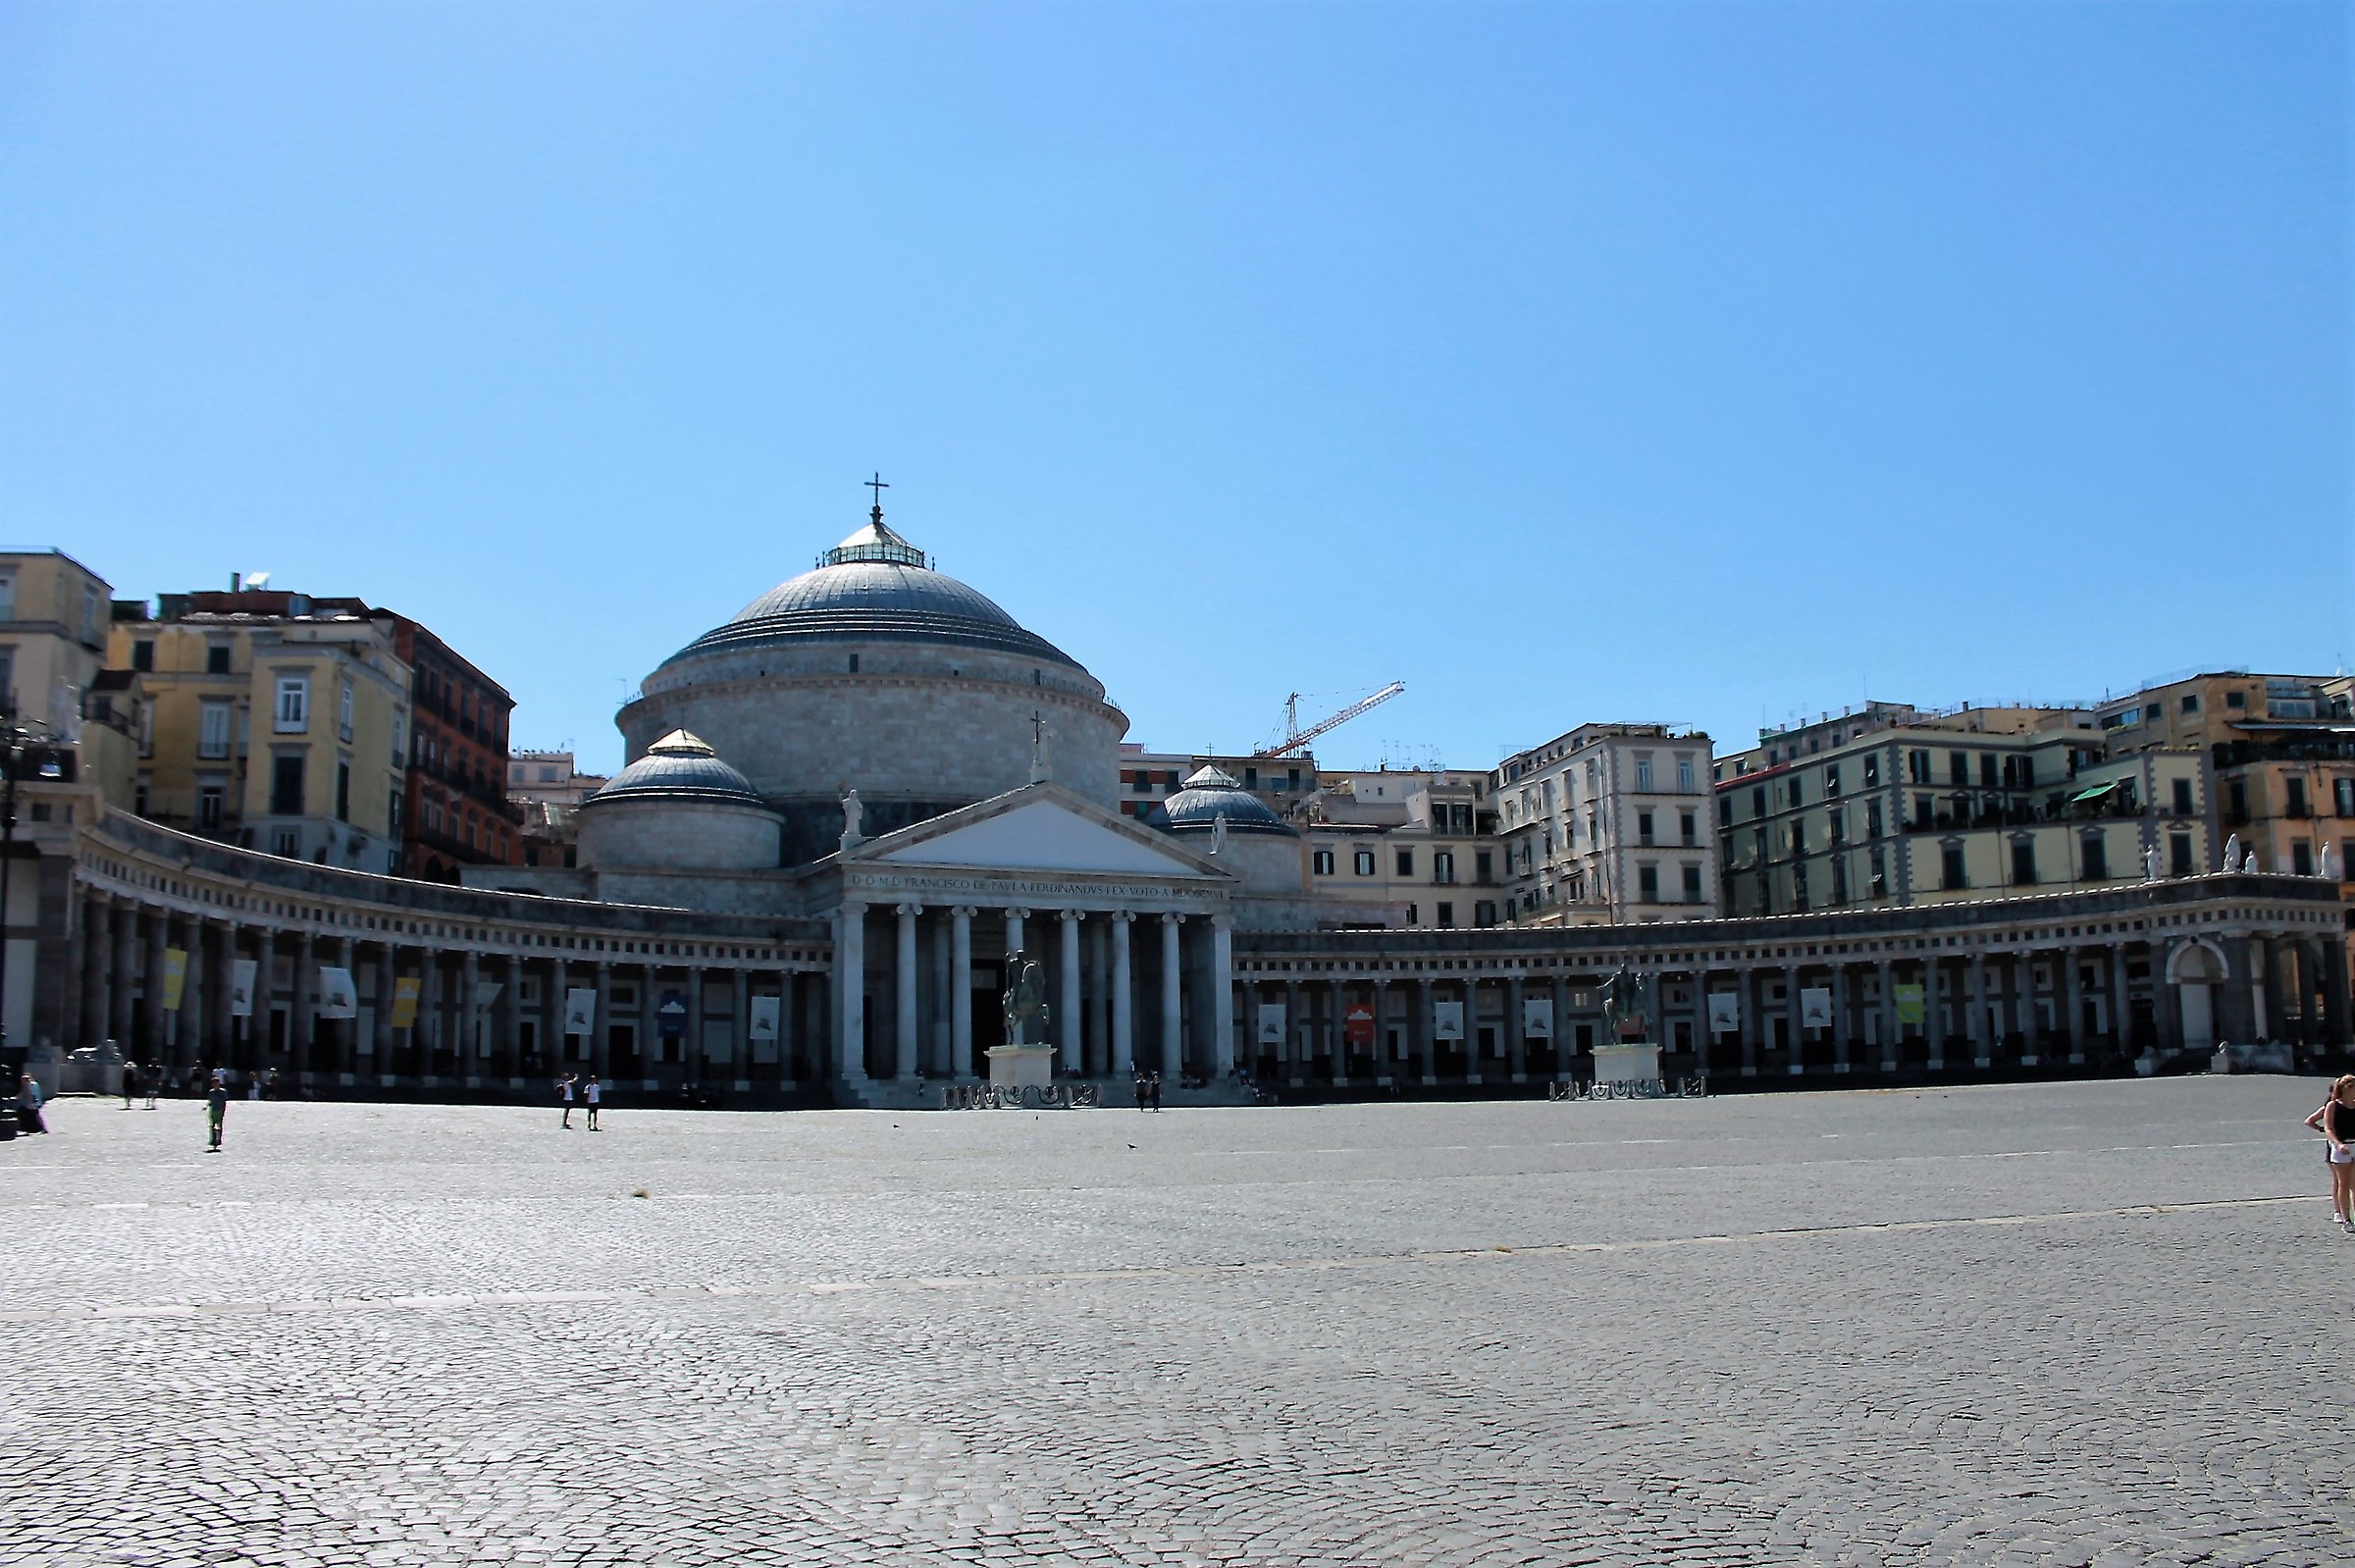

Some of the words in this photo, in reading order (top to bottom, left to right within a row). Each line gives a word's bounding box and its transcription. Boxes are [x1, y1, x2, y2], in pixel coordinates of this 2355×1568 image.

[905, 877, 969, 889] FRANCISCO
[1112, 885, 1125, 896] EX
[1128, 886, 1158, 897] VOTO
